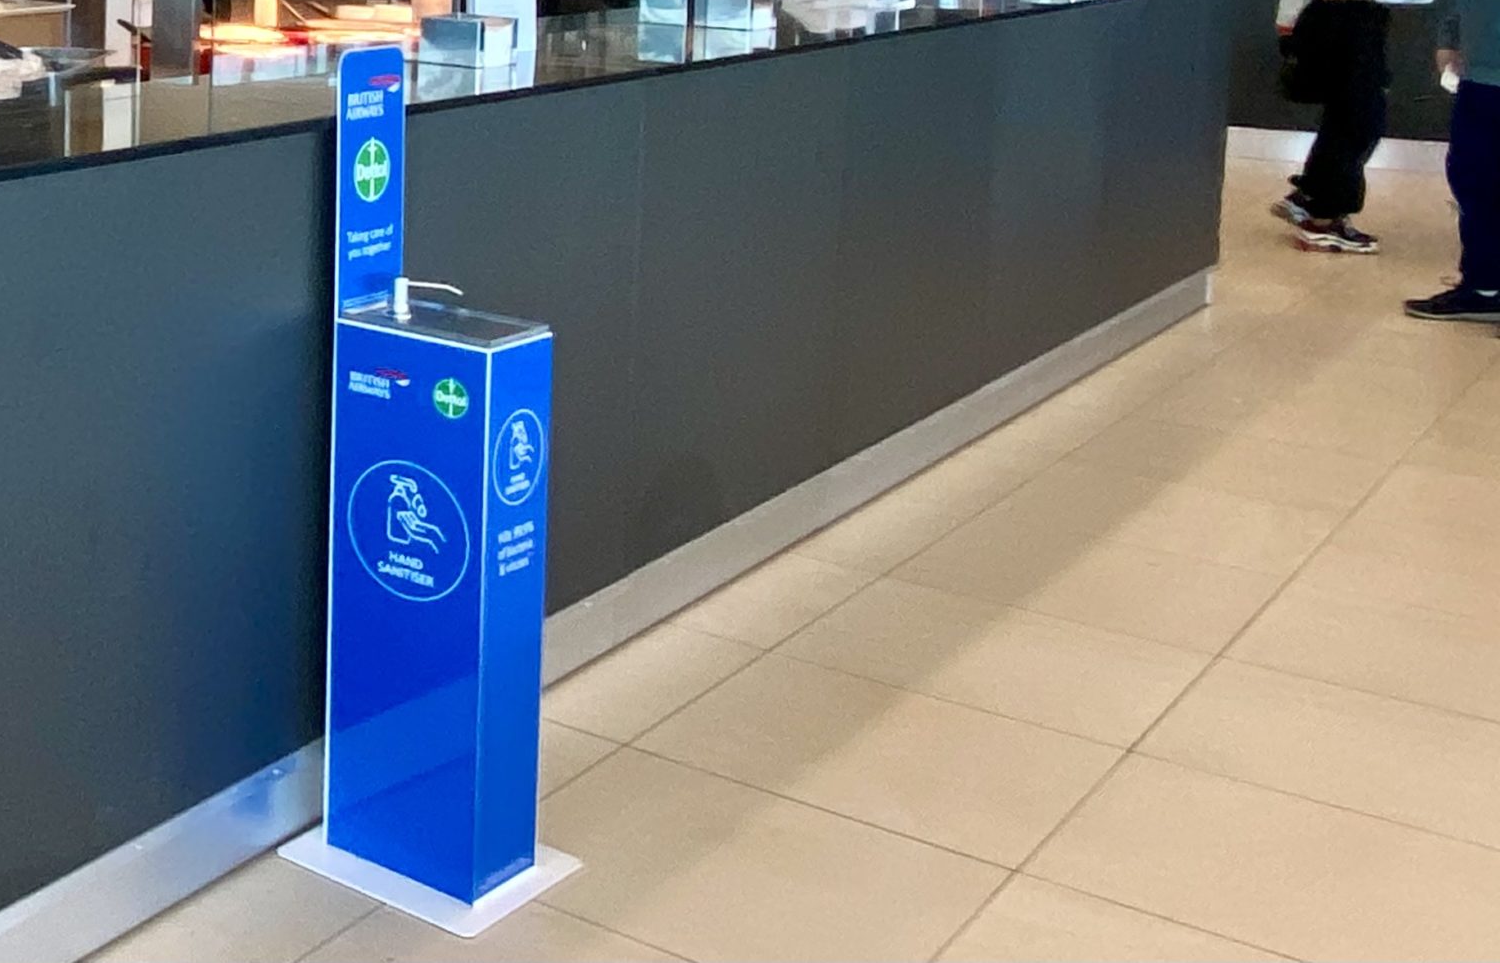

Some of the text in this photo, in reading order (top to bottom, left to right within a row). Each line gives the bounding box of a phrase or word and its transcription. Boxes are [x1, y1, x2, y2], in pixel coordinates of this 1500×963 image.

[347, 89, 384, 108] BRITISH
[345, 103, 385, 122] AIRWAYS
[356, 159, 389, 181] Dettol
[346, 230, 369, 244] Taking
[348, 370, 391, 389] BRITISH
[388, 549, 424, 570] HAND
[377, 560, 435, 588] SANITISER
